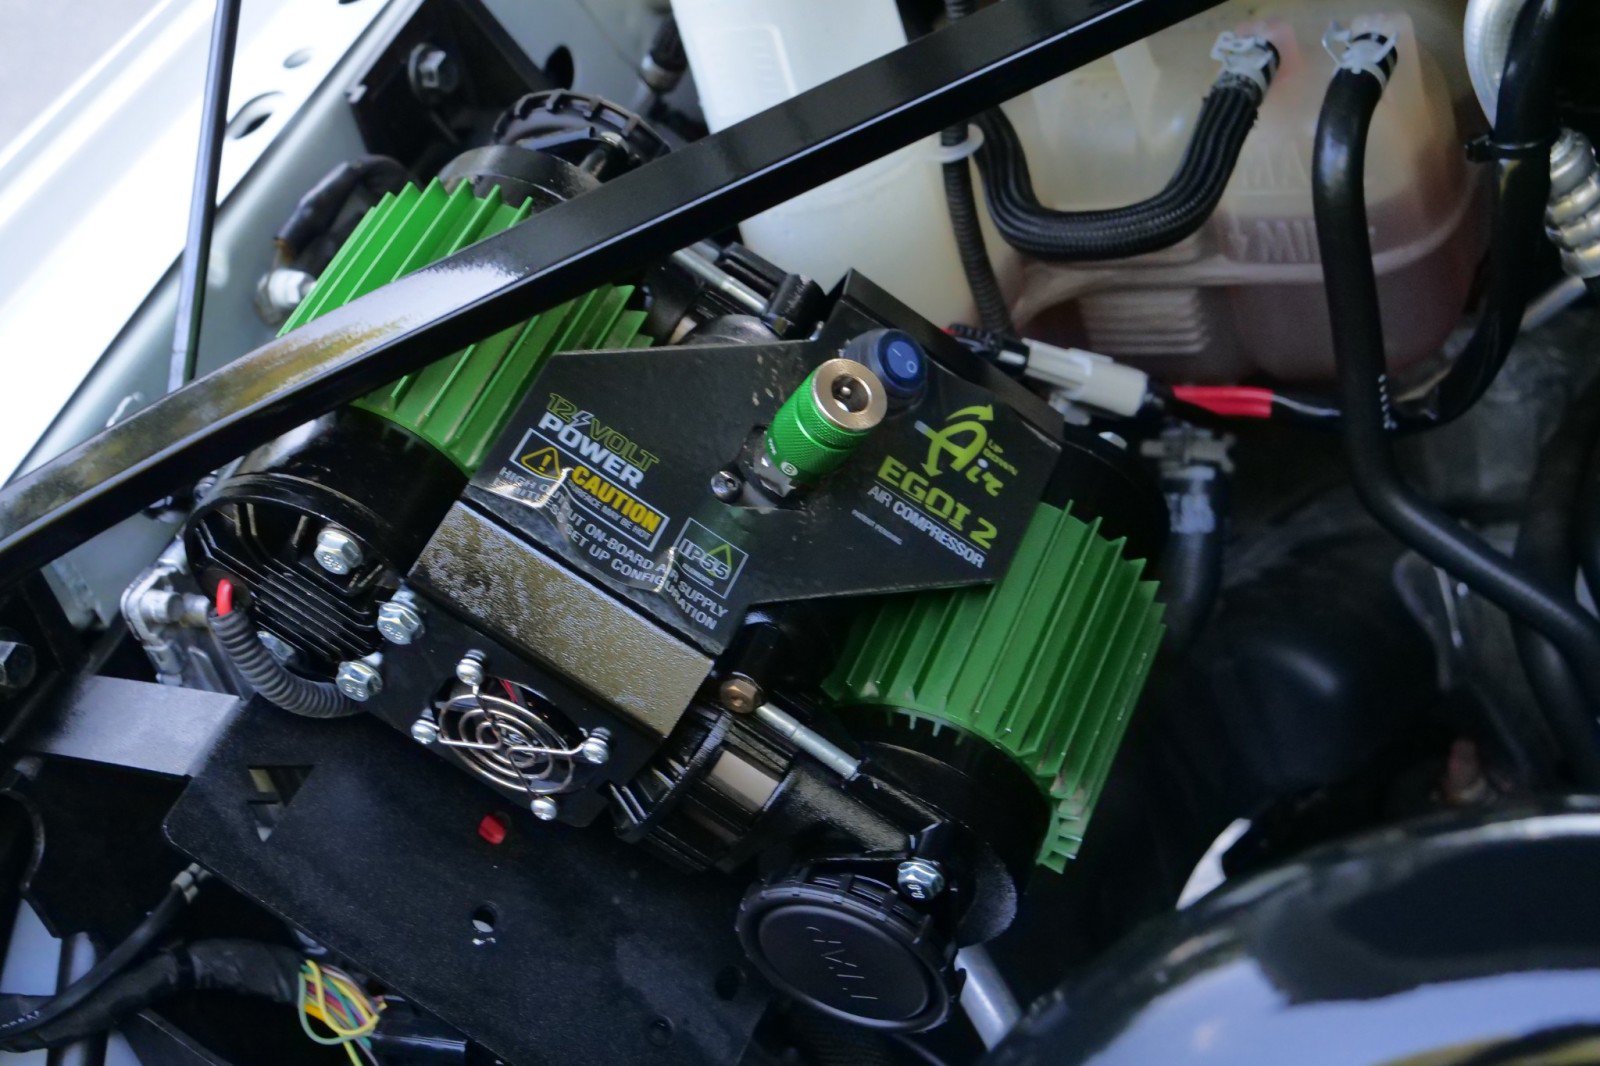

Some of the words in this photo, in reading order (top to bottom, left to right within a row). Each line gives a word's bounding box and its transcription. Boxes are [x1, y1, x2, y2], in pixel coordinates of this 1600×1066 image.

[538, 411, 645, 489] POWER
[547, 392, 578, 423] 12
[590, 417, 660, 472] VOLT
[567, 480, 602, 510] SURFACE
[600, 504, 621, 521] MAY
[619, 518, 633, 530] BE
[631, 525, 652, 541] HOT
[571, 465, 661, 533] CAUTION
[867, 485, 894, 508] AIR
[892, 501, 986, 569] COMPRESSOR
[969, 516, 998, 550] 2
[499, 466, 538, 490] HIGH
[538, 483, 587, 527] OUTPUT
[584, 523, 655, 571] ON-BOARD
[654, 562, 679, 583] AR
[678, 580, 729, 618] SUPPLY
[565, 523, 590, 548] SET
[589, 543, 611, 560] UP
[610, 558, 718, 631] CONFIGURATION
[677, 537, 732, 580] IP55
